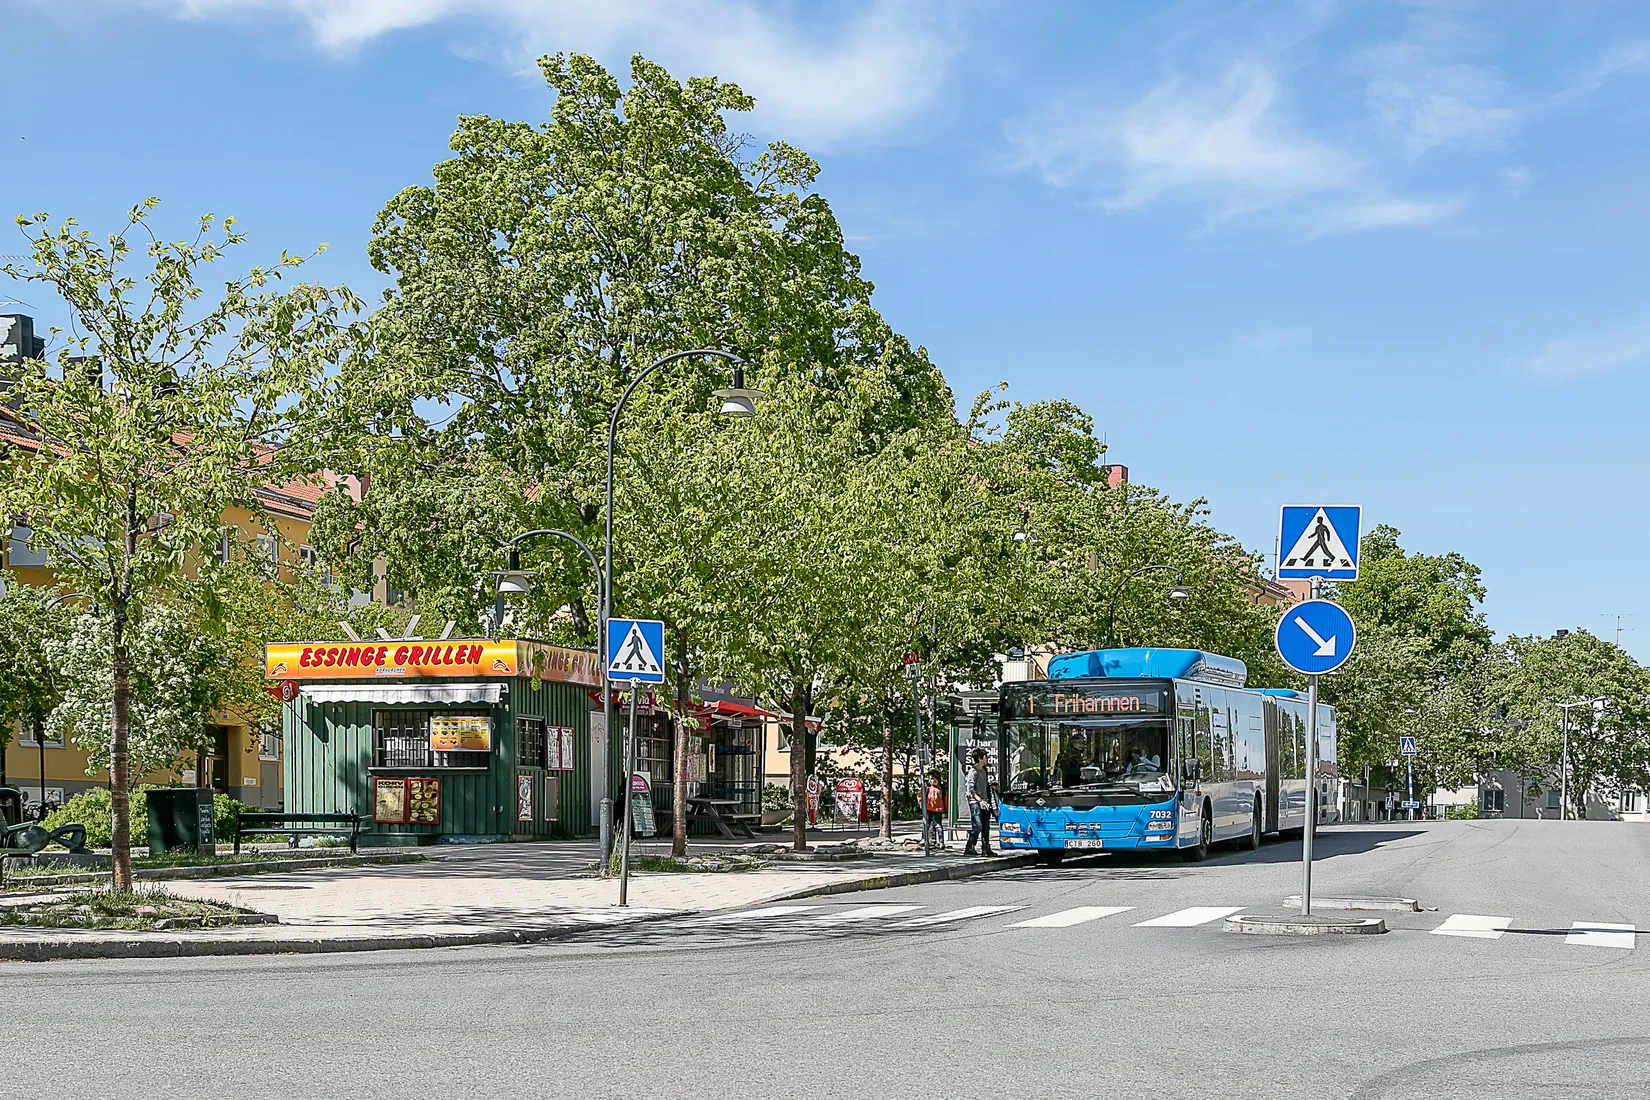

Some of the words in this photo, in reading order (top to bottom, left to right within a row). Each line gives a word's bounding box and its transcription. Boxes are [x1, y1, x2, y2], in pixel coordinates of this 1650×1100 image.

[299, 645, 388, 668] ESSINGE
[394, 644, 484, 667] GRILLEN
[1028, 695, 1035, 714] 1
[1054, 693, 1139, 713] Frihamnen
[965, 738, 976, 747] Vi
[977, 739, 992, 747] har
[1150, 810, 1171, 819] 7032
[1065, 822, 1102, 831] MAN
